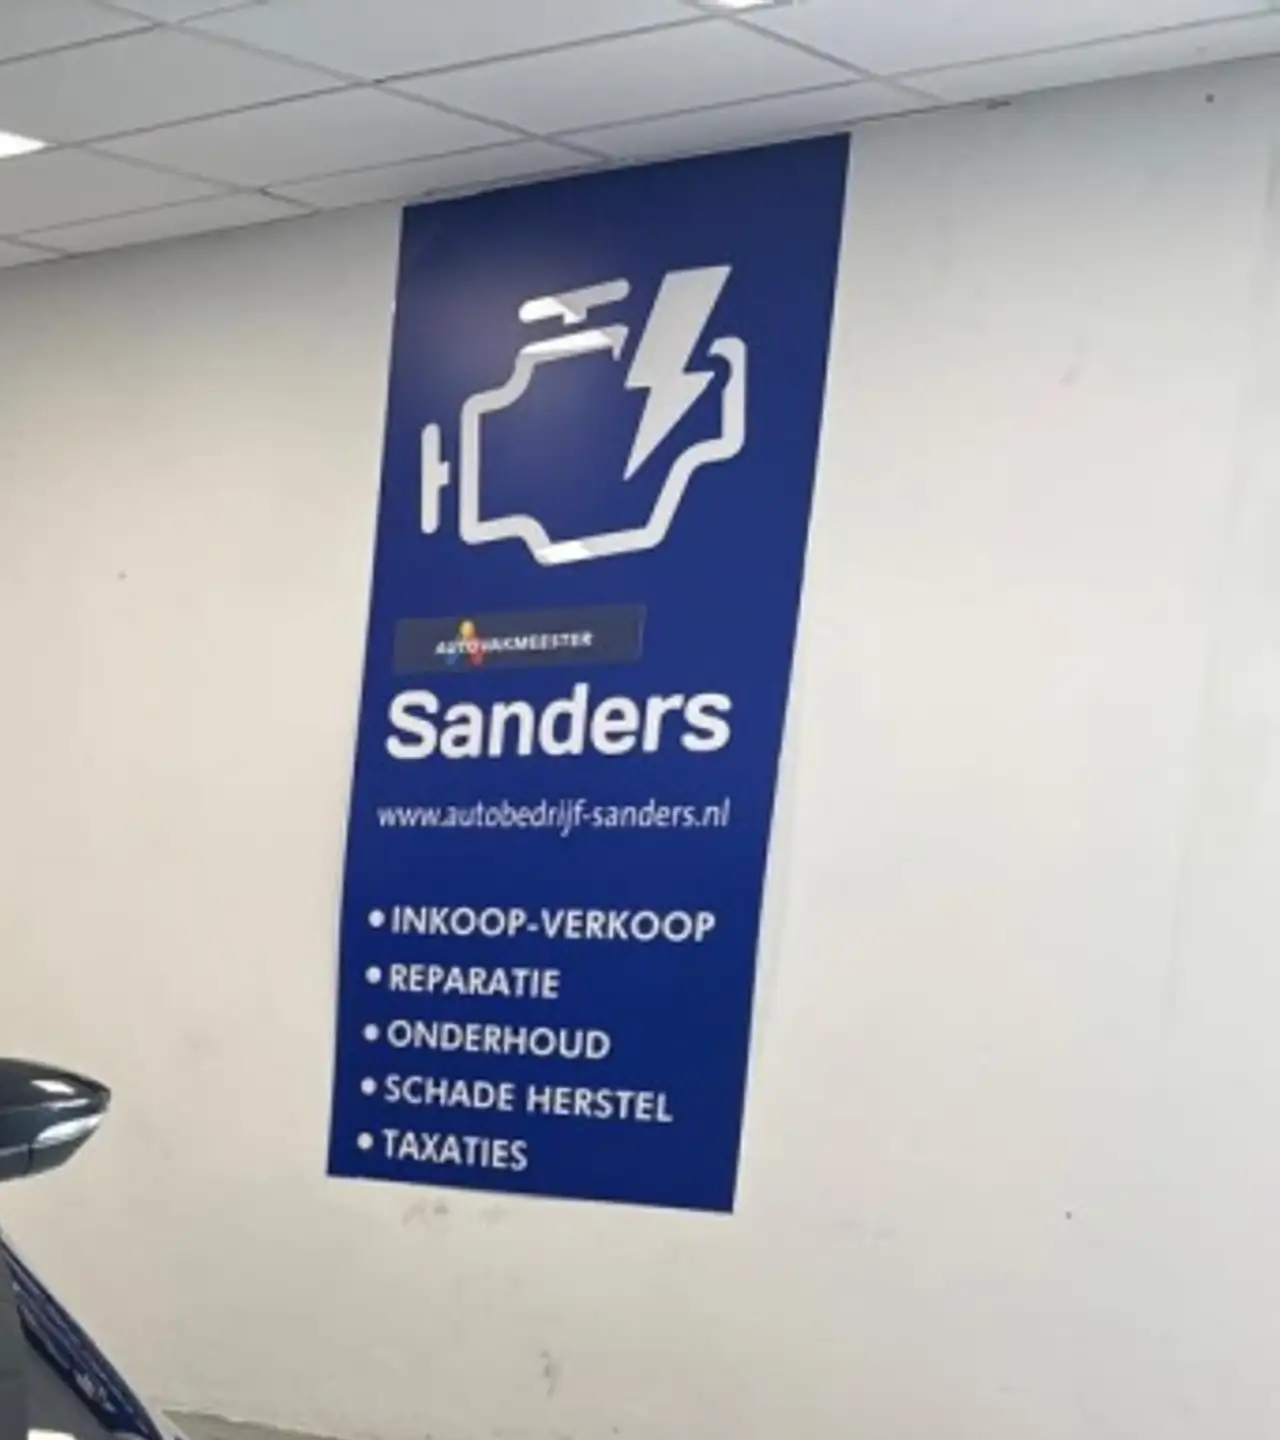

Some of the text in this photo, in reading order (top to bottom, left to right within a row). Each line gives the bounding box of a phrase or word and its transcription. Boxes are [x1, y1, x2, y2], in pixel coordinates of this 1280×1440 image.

[385, 683, 732, 759] Sanders
[377, 798, 731, 837] www.autobedrijf-sanders.nl
[391, 905, 716, 942] INKOOP-VERKOOP
[388, 963, 560, 999] REPARATIE
[387, 1019, 611, 1059] ONDERHOUD
[384, 1074, 673, 1123] SCHADE HERSTEL
[382, 1127, 528, 1172] TAXATIES
